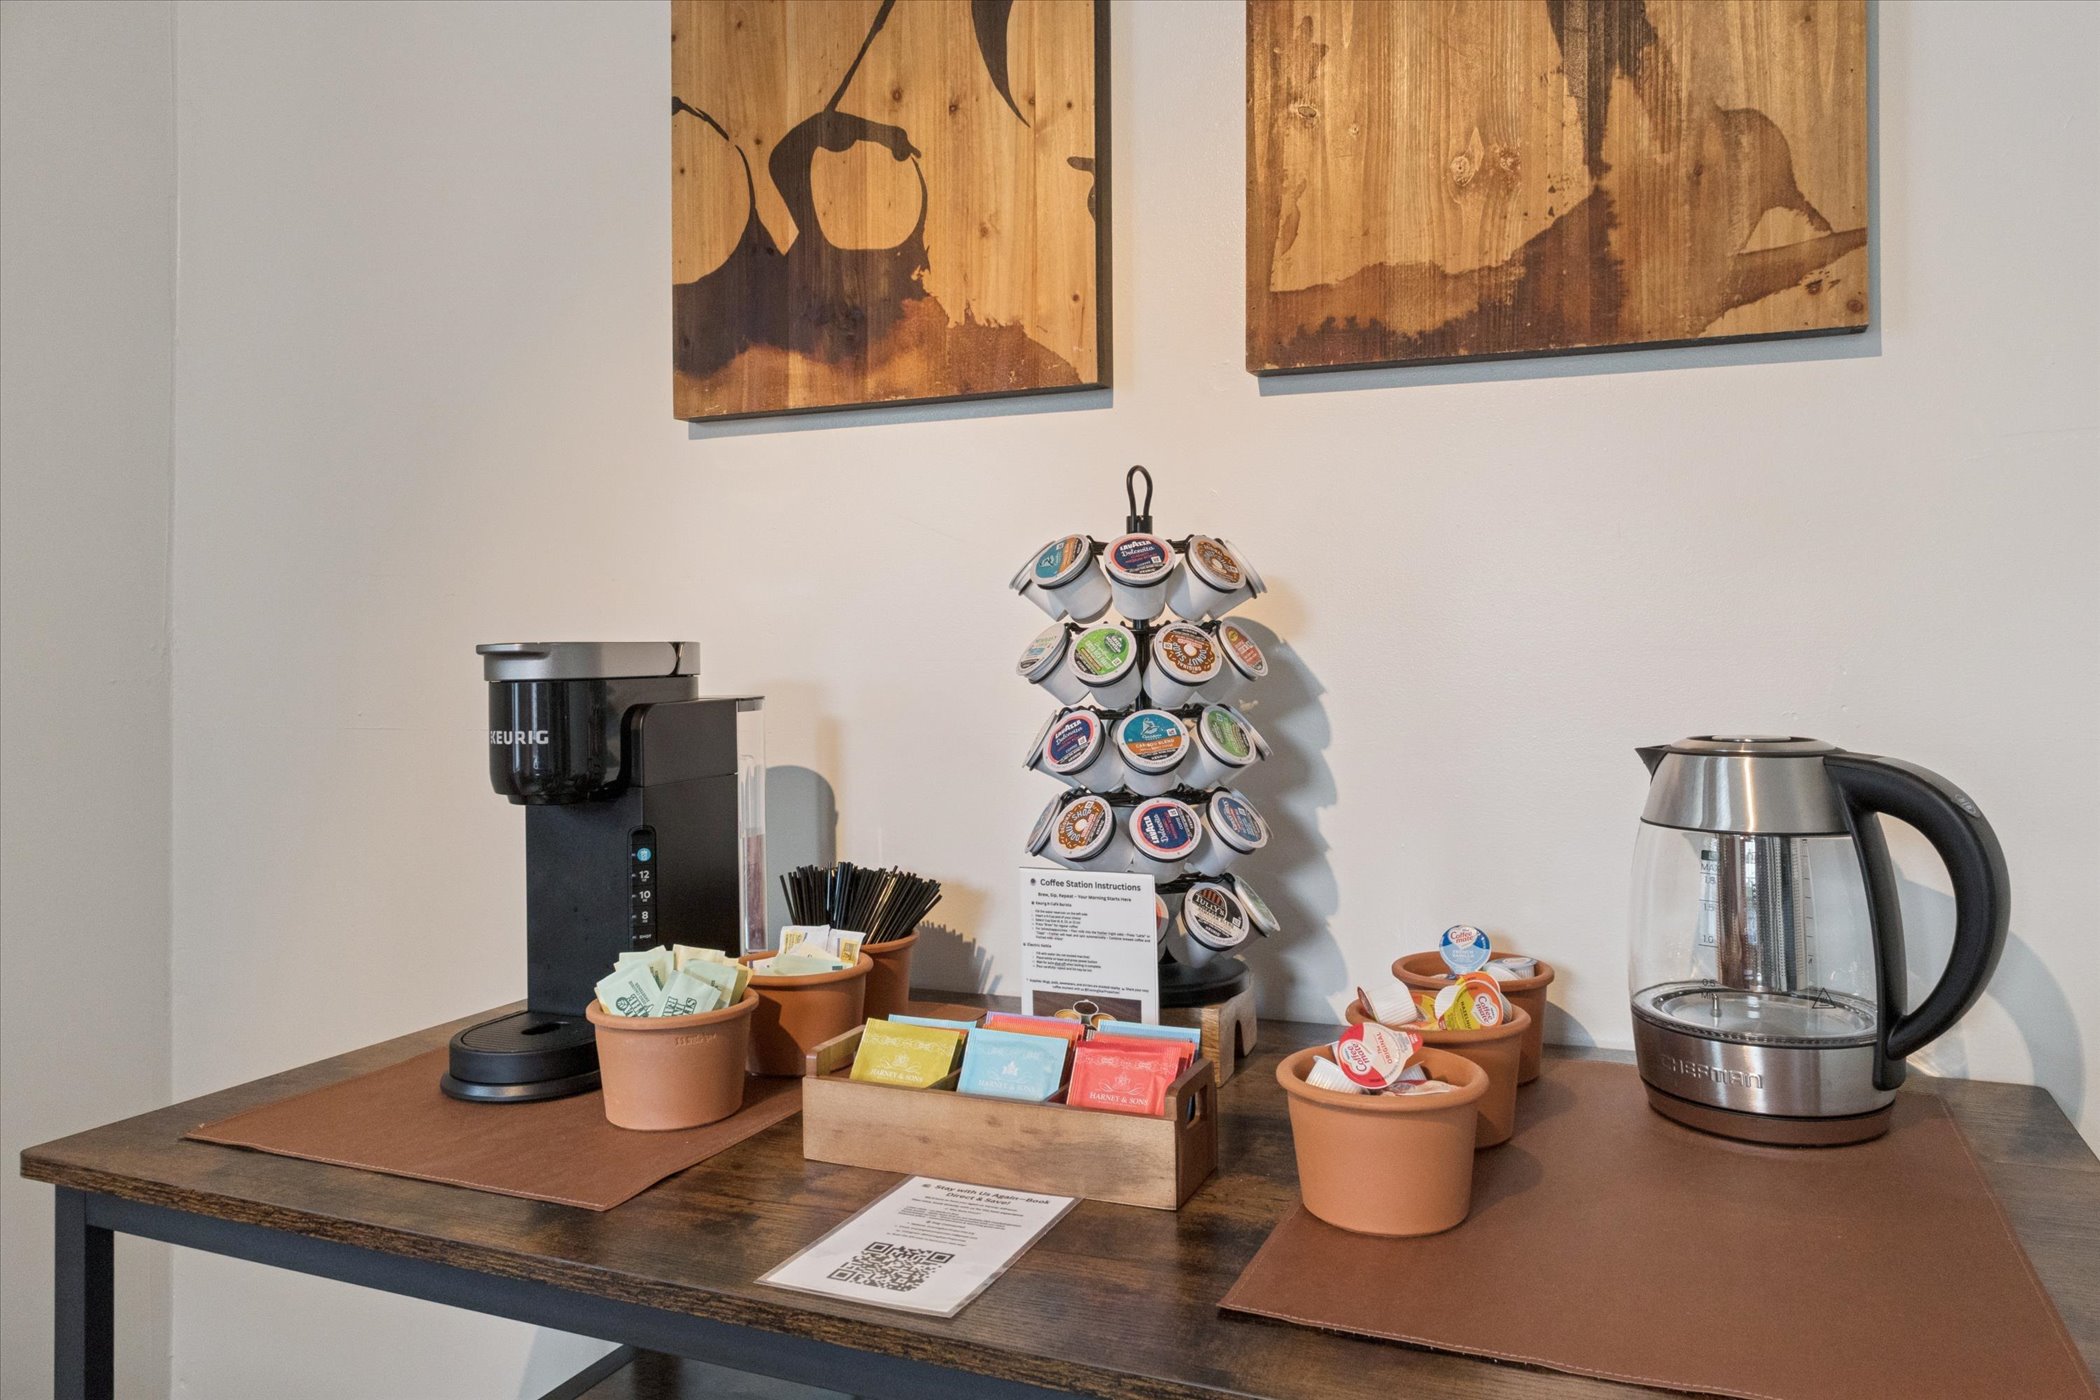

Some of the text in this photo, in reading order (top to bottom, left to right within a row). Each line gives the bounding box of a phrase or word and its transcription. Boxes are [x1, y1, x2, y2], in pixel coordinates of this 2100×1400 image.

[1172, 642, 1187, 662] SHOP
[1188, 649, 1207, 667] DONUT
[490, 730, 549, 745] KEURIG
[1072, 807, 1091, 820] SHOP
[1066, 822, 1081, 841] DONUT
[1144, 815, 1160, 844] LAVAZZA
[639, 870, 650, 879] 12
[1040, 879, 1141, 891] Coffee Station Instructions
[639, 890, 651, 900] 10
[1195, 894, 1226, 916] TULLY'S
[641, 911, 649, 920] 8
[1450, 931, 1474, 940] Coffee
[1455, 936, 1475, 944] mate
[1703, 935, 1714, 944] 1.0
[1702, 979, 1716, 987] 0.5
[1461, 1001, 1472, 1030] HAZELNU
[1476, 1004, 1490, 1023] mate
[1478, 996, 1493, 1020] Coffee
[1353, 1043, 1370, 1064] mate
[1376, 1032, 1393, 1064] ORIGINAL
[1348, 1046, 1367, 1072] Coffee
[870, 1068, 897, 1079] HARNEY
[905, 1073, 923, 1082] SONS
[1088, 1091, 1120, 1102] HARNEY
[1129, 1097, 1148, 1106] SONS
[934, 1184, 956, 1192] Stay
[946, 1192, 975, 1201] Direct
[984, 1198, 1012, 1206] Save!
